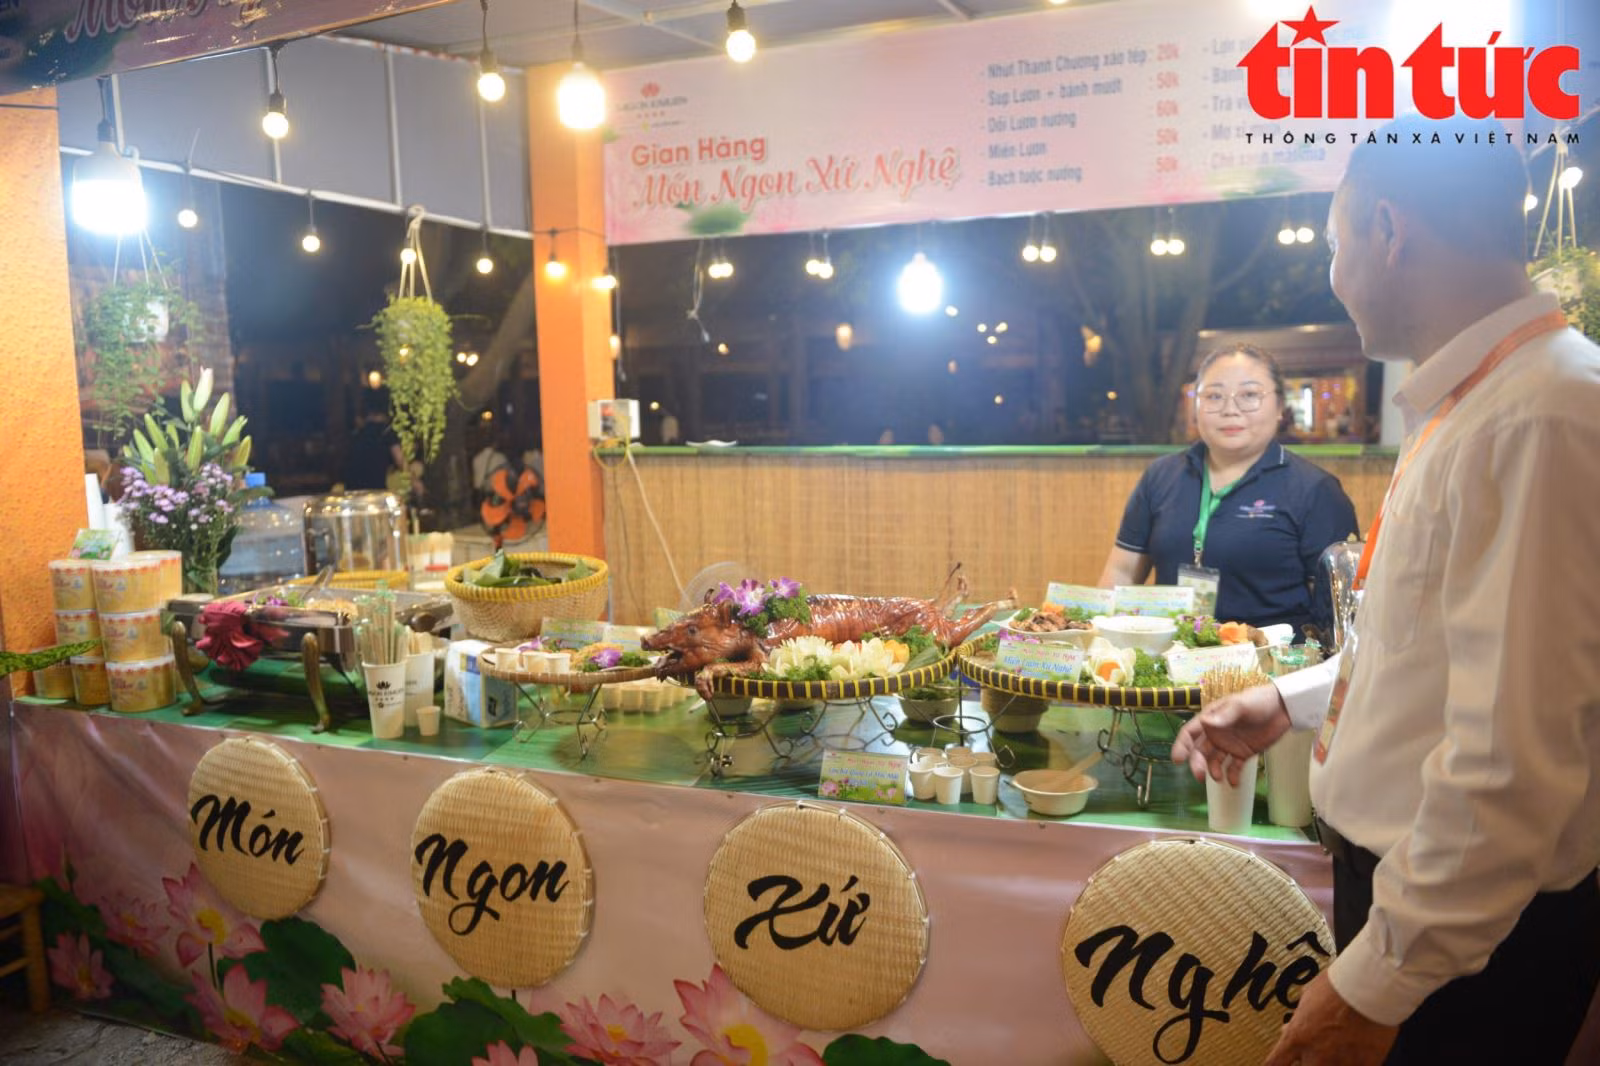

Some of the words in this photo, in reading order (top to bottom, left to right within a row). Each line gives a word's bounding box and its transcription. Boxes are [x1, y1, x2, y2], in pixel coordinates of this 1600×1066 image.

[632, 141, 690, 167] Gian
[698, 135, 767, 163] Hàng
[711, 165, 795, 213] Ngon
[864, 147, 960, 200] Nghệ
[191, 794, 304, 865] Món
[414, 832, 570, 936] Ngon
[734, 875, 870, 950] Xứ
[1074, 925, 1330, 1065] Nghệ
